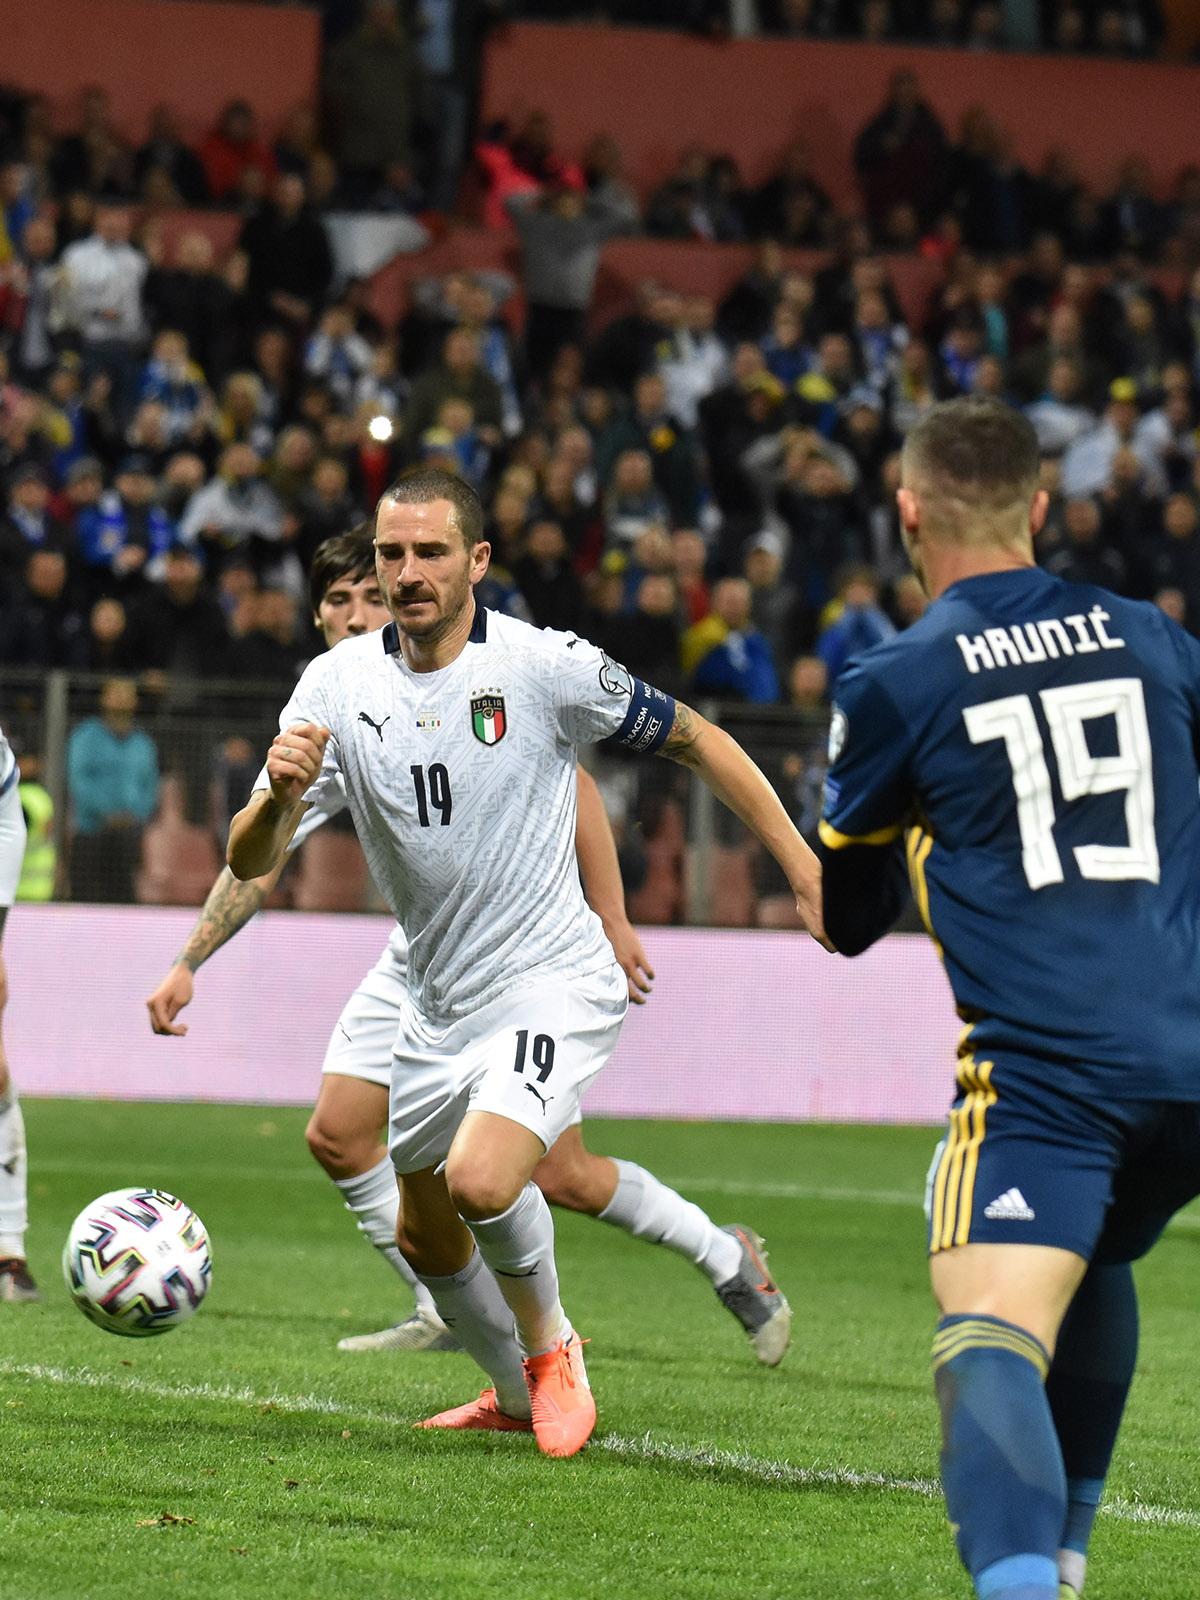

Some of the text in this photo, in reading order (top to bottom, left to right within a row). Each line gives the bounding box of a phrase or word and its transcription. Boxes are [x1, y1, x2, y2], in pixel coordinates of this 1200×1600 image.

[956, 605, 1125, 674] KRUNIĆ
[473, 699, 503, 710] ITALIA
[627, 706, 649, 739] RACISM
[410, 762, 453, 828] 19
[962, 677, 1160, 891] 19
[513, 1029, 556, 1084] 19
